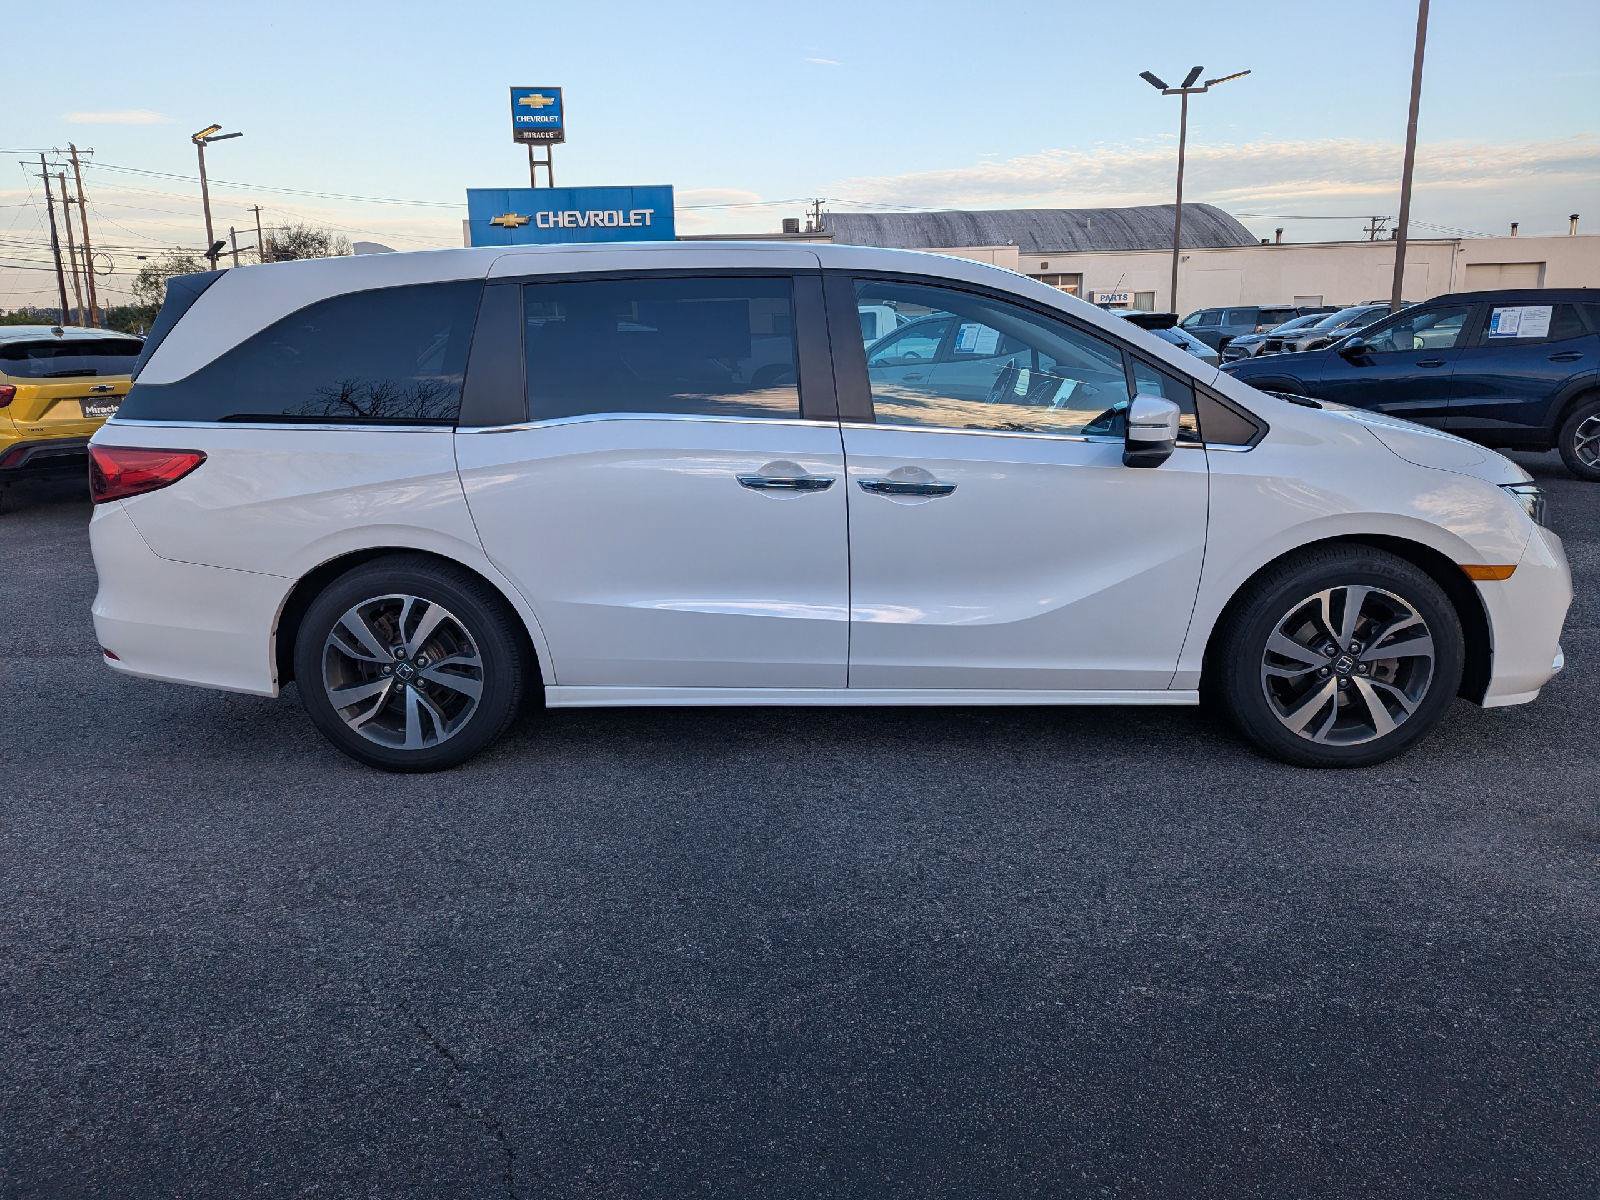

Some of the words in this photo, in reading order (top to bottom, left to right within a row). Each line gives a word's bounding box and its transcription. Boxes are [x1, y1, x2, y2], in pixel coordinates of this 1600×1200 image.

[516, 115, 559, 123] CHEVROLET
[523, 131, 554, 139] MIRACLE
[535, 209, 655, 229] CHEVROLET
[1100, 294, 1128, 302] PARTS
